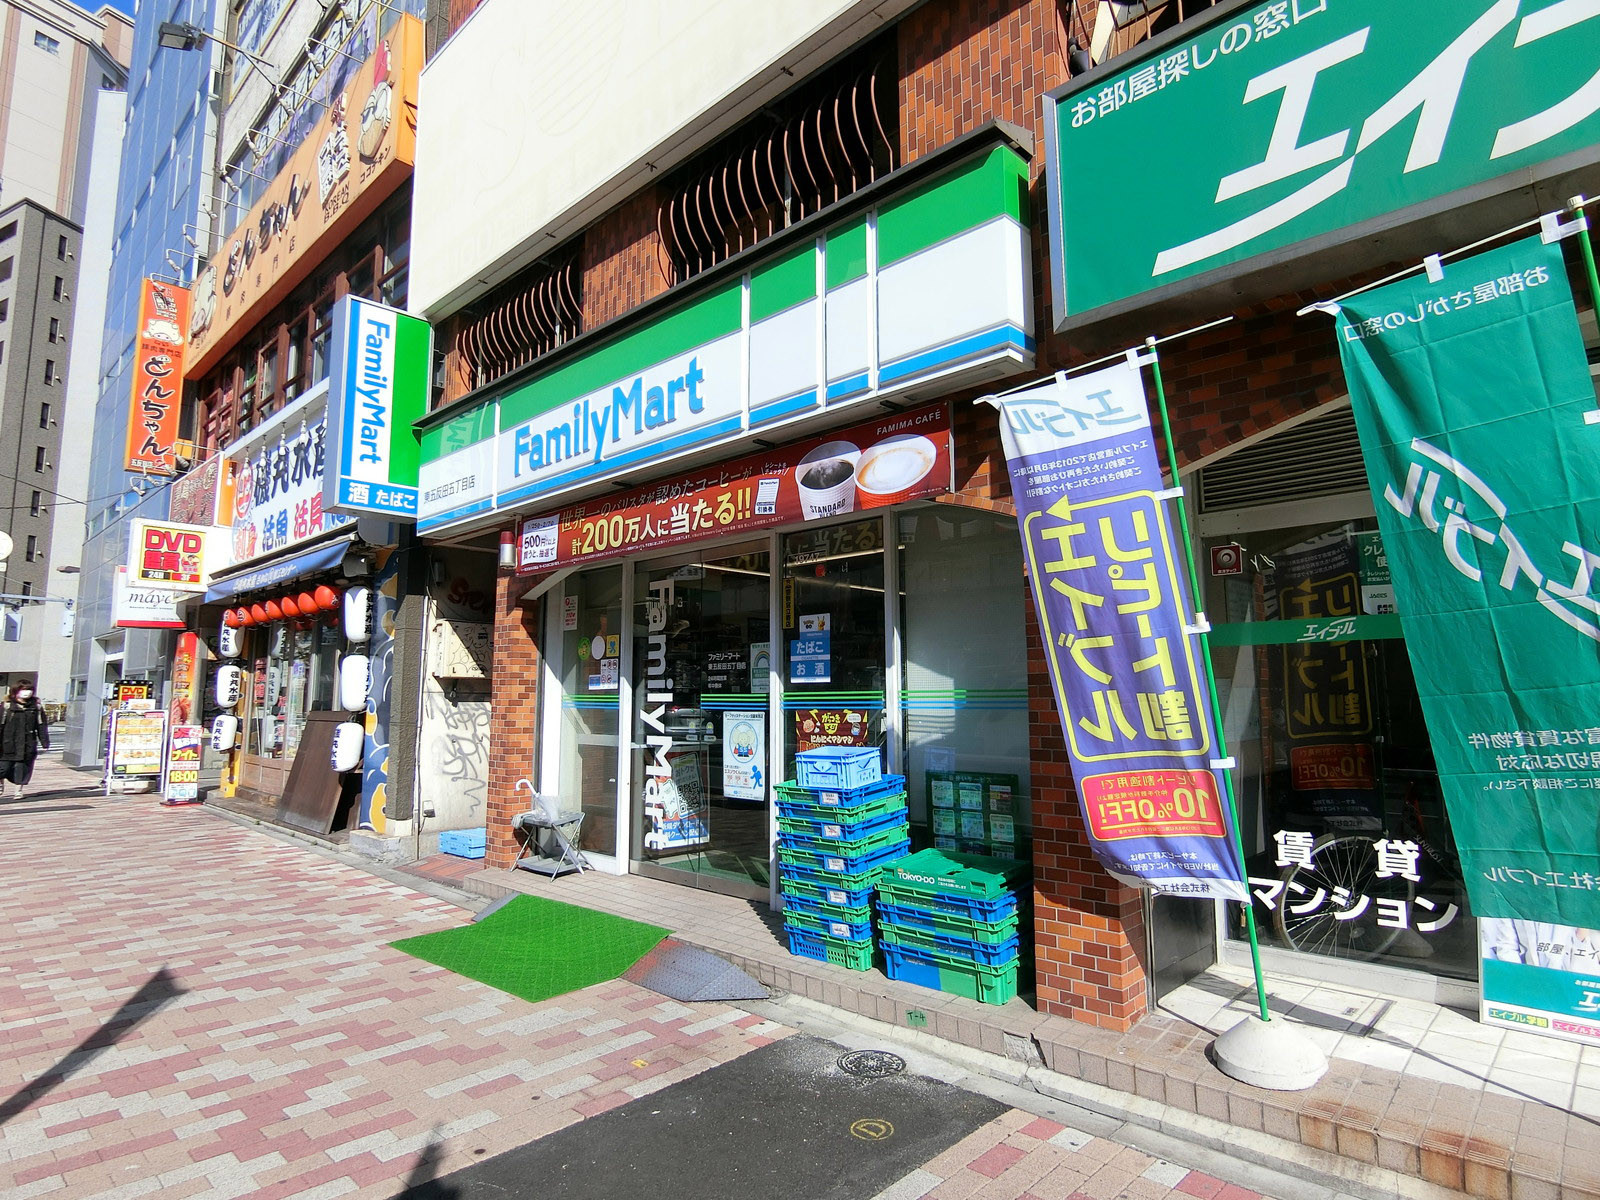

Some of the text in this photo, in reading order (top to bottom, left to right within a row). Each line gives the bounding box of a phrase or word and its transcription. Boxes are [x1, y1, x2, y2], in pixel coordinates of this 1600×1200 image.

[323, 181, 350, 213] KOREAN
[356, 319, 390, 465] FamilyMart
[514, 356, 705, 477] FamilyMart
[876, 408, 941, 436] FAMIMA CAFÉ
[348, 483, 416, 510] 酒 たばこ
[424, 475, 476, 504] 東五反田五丁目店
[561, 466, 753, 532] 世界一のバリスタが認めたコーヒーが
[809, 498, 846, 514] STANDARD
[145, 528, 201, 553] DVD
[1297, 617, 1357, 642] エイブル
[708, 652, 741, 660] ファミリーマート
[797, 641, 824, 654] たばこ
[797, 662, 824, 675] お酒
[640, 580, 674, 849] FamilyMart
[170, 770, 197, 782] 18:00
[898, 872, 935, 885] TOKYO-DO
[1248, 875, 1459, 934] マンション
[907, 1012, 925, 1022] T-4
